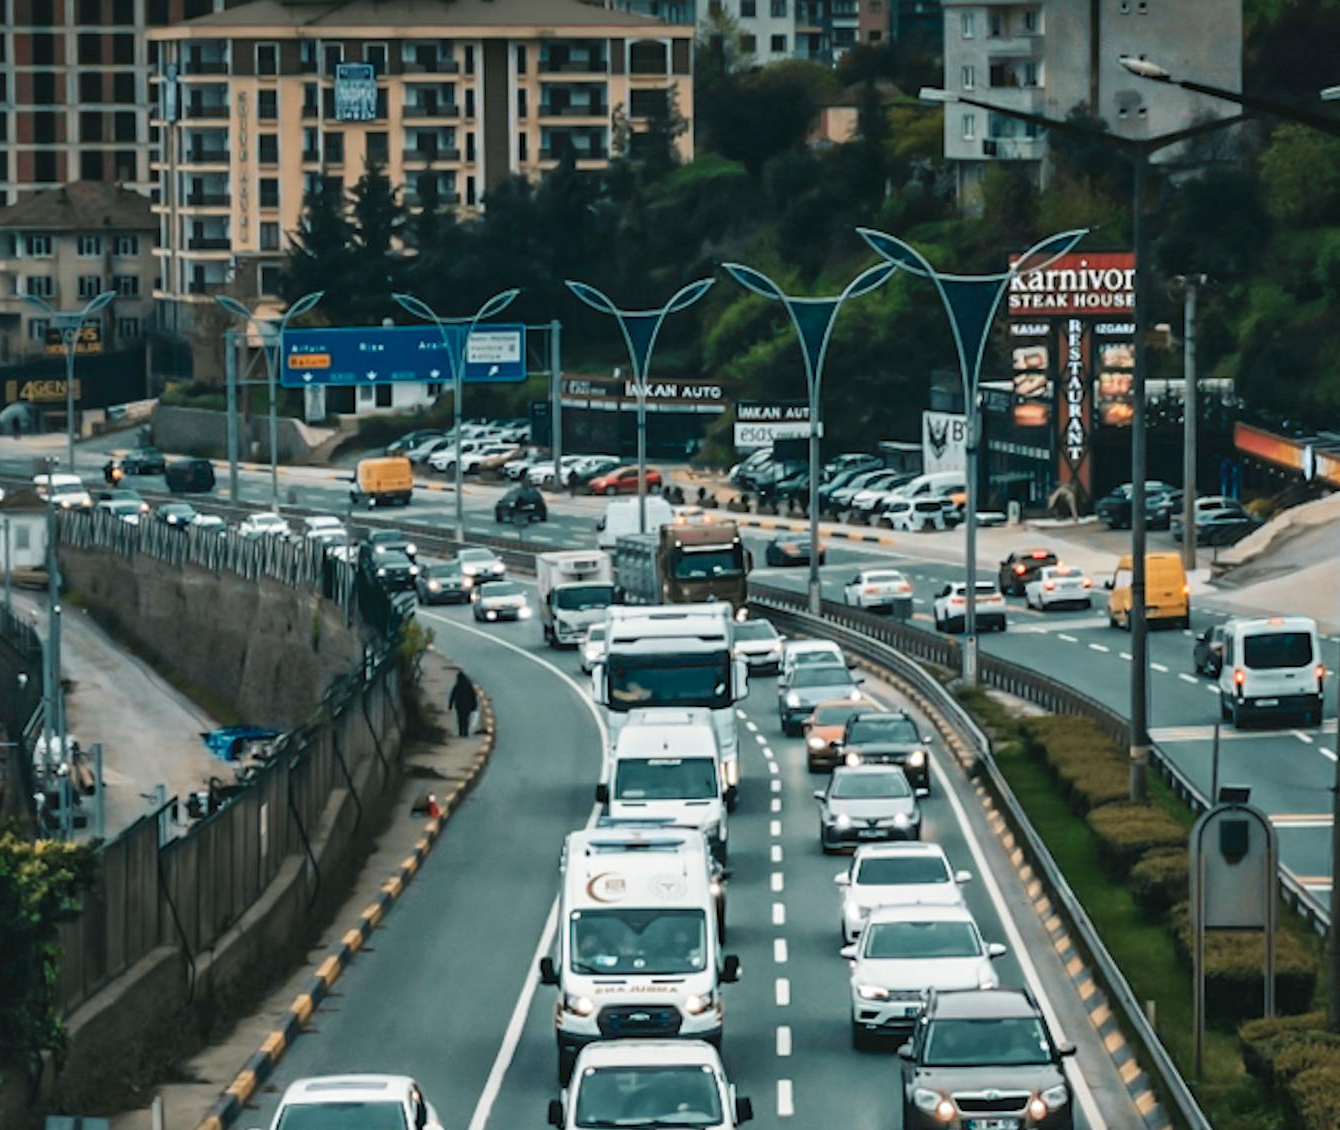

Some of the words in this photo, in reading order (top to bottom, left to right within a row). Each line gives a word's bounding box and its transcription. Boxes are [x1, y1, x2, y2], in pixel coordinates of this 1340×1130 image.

[1008, 293, 1068, 308] STEAK
[1073, 292, 1136, 308] HOUSE
[681, 386, 722, 398] AUTO
[1067, 319, 1083, 460] RESTAURANT
[785, 406, 810, 418] AUT
